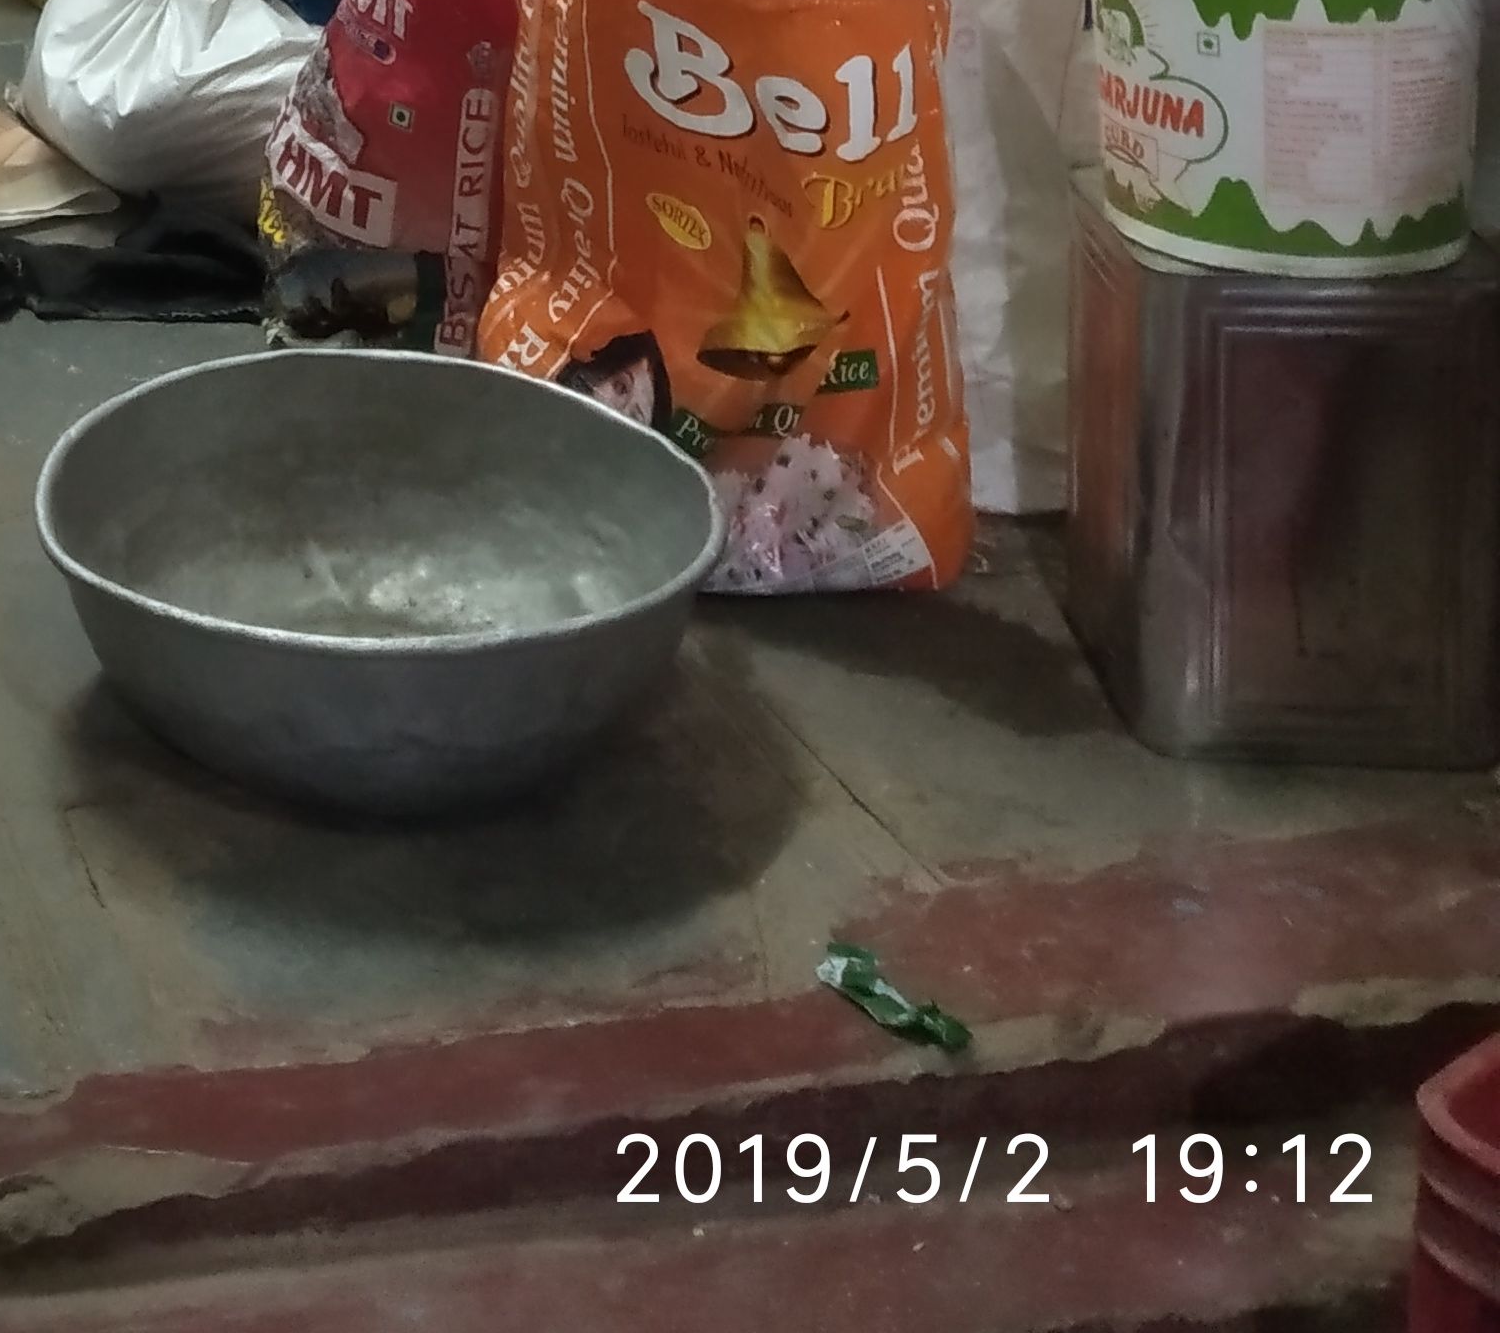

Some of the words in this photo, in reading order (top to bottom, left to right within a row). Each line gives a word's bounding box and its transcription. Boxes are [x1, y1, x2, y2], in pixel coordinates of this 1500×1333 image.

[624, 0, 918, 162] Bell
[277, 145, 383, 229] HMT
[458, 99, 493, 197] RICE
